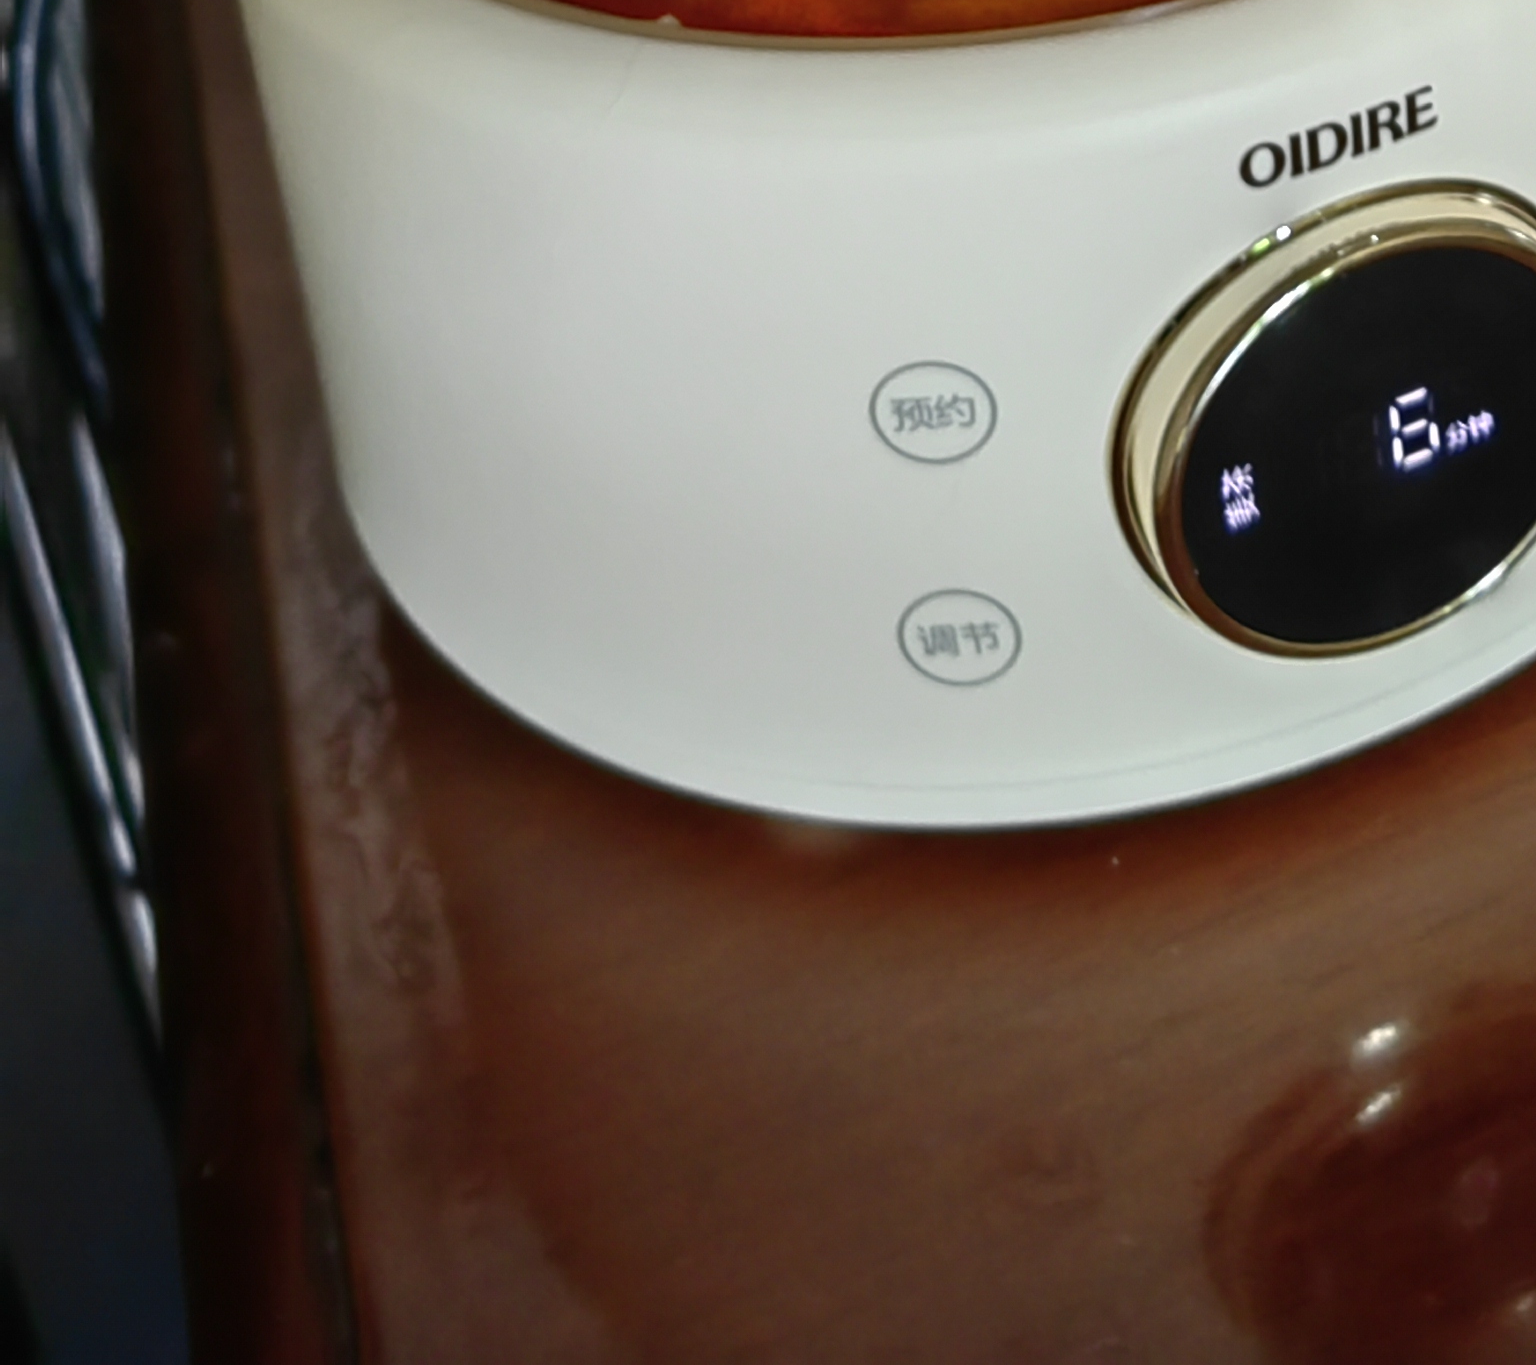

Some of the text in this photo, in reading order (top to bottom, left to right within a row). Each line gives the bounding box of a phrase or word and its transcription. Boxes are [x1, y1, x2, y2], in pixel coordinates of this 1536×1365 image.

[1238, 84, 1439, 189] OIDIRE
[889, 393, 976, 433] 预约
[1388, 386, 1441, 472] 6
[917, 621, 1000, 658] 调节
